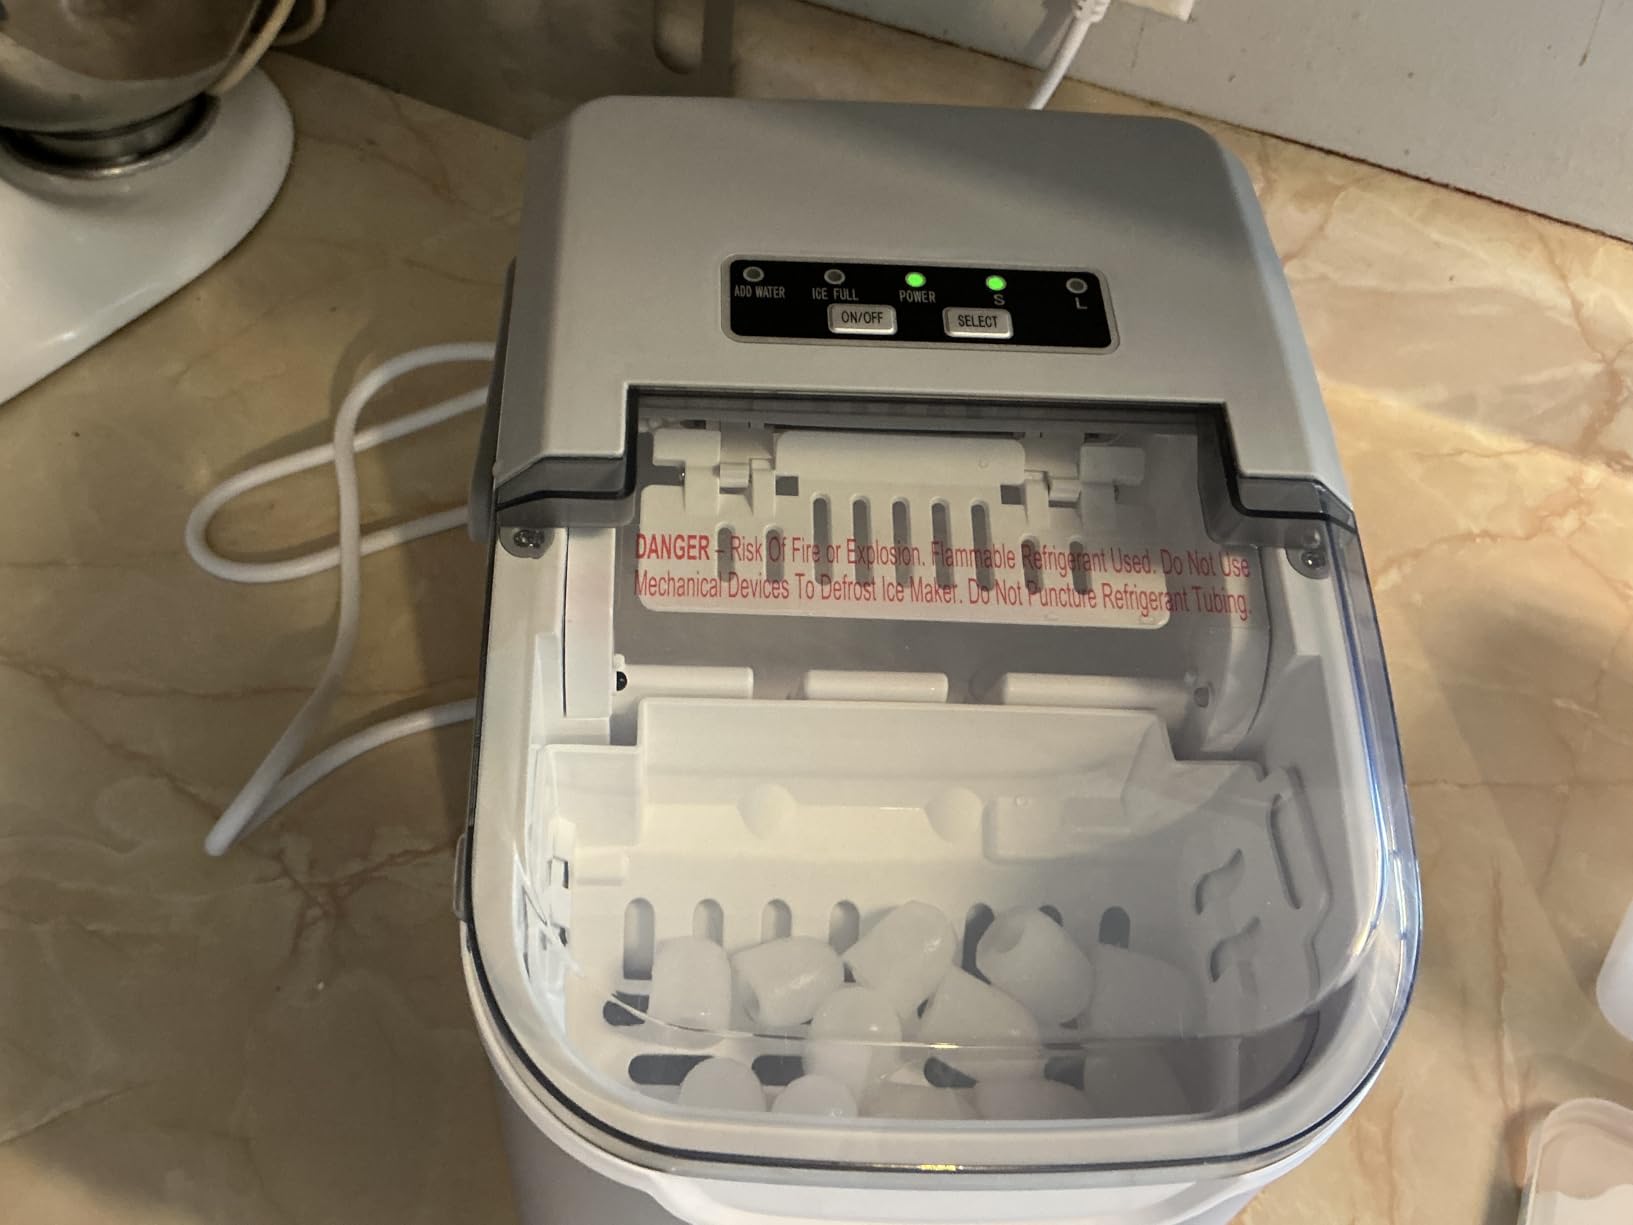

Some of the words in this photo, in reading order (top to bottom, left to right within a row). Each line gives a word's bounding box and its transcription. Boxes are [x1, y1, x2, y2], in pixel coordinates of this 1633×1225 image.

[734, 285, 752, 298] ADD
[755, 286, 785, 299] WATER
[812, 287, 828, 300] ICE
[833, 288, 859, 301] FULL
[899, 290, 936, 303] POWER
[993, 294, 1005, 306] S
[1075, 297, 1088, 310] L
[841, 310, 883, 324] ON/OFF
[958, 315, 998, 328] SELECT
[635, 533, 710, 561] DANGER
[730, 535, 763, 562] Risk
[768, 536, 787, 563] Of
[792, 537, 820, 563] Fire
[826, 543, 841, 564] or
[847, 538, 925, 570] Explosion.
[931, 541, 1016, 569] Flammable
[1021, 543, 1107, 577] Refrigerant
[1110, 547, 1157, 575] Used.
[1160, 548, 1183, 576] Do
[1187, 549, 1216, 577] Not
[1221, 551, 1250, 578] Use
[634, 569, 722, 598] Mechanical
[728, 571, 790, 600] Devices
[795, 573, 815, 600] To
[821, 573, 877, 601] Defrost
[882, 576, 904, 602] Ice
[910, 576, 962, 604] Maker.
[968, 578, 990, 605] Do
[994, 579, 1023, 606] Not
[1027, 580, 1097, 609] Puncture
[1102, 582, 1190, 617] Refrigerant
[1192, 586, 1252, 620] Tubing.
